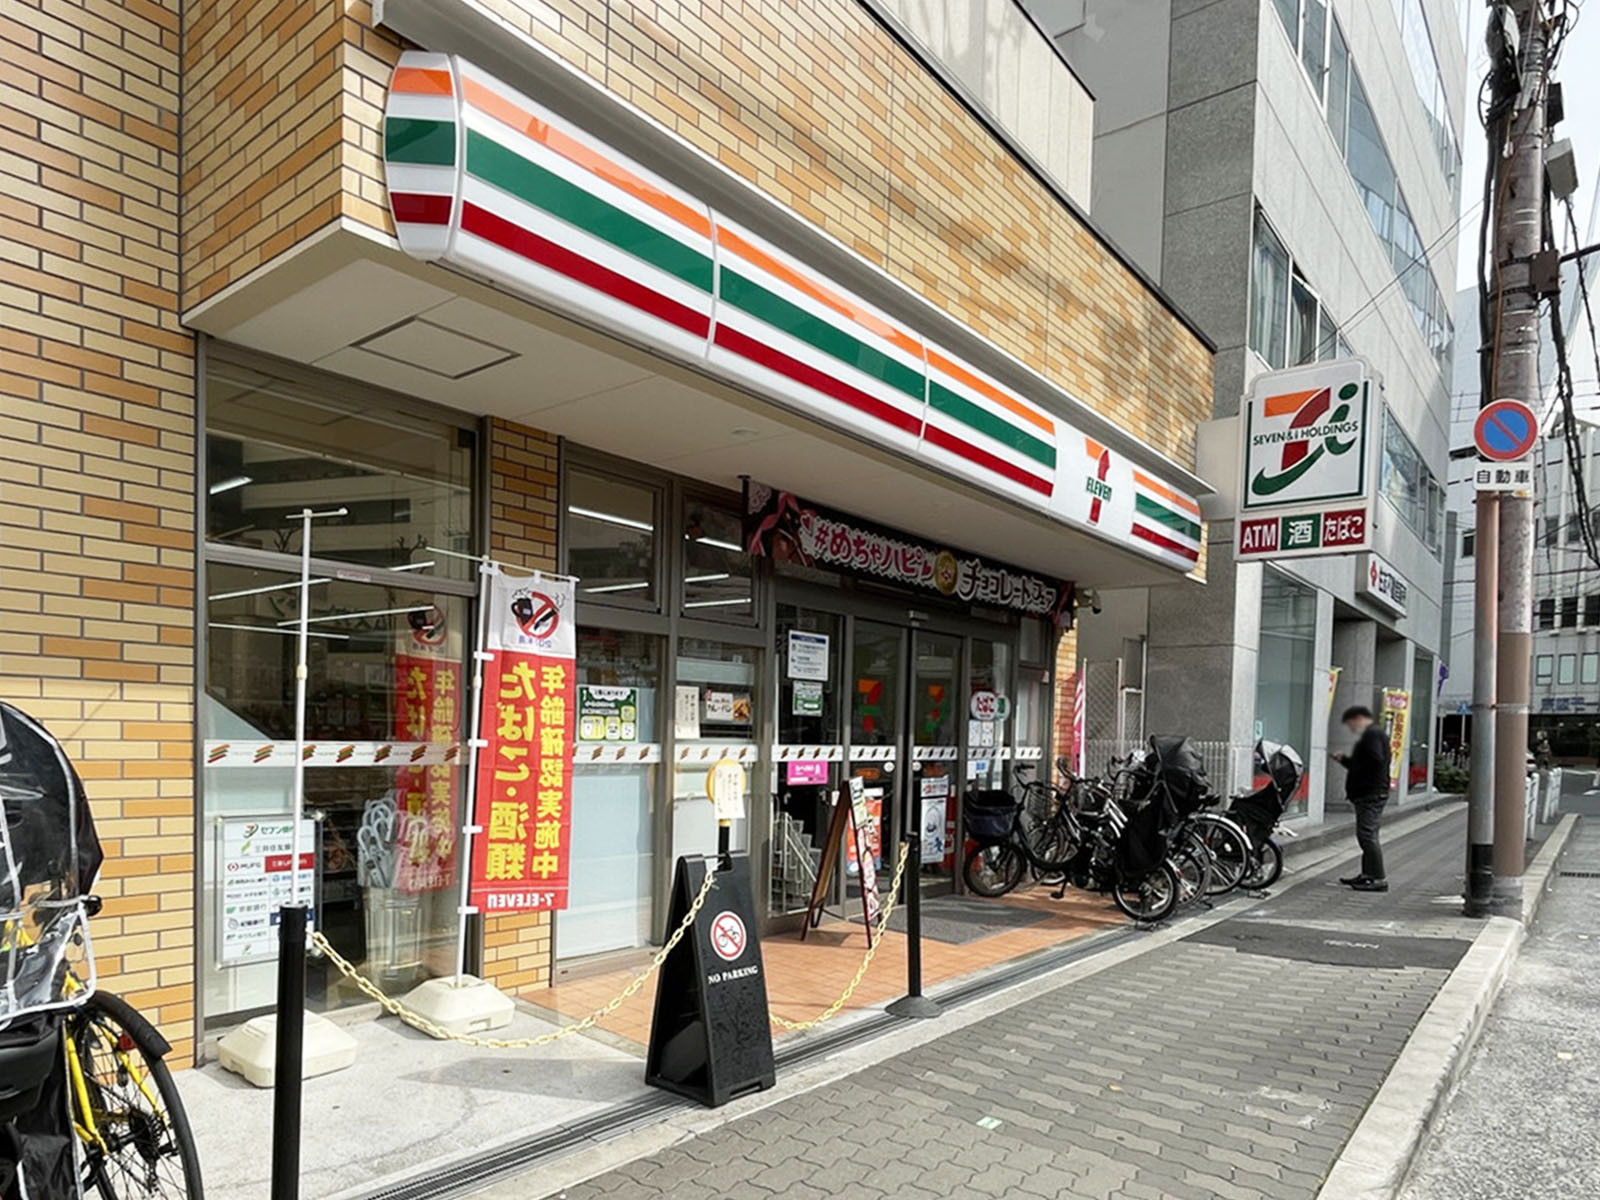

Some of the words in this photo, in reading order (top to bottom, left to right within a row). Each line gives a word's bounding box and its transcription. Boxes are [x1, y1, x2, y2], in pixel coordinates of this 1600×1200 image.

[1301, 420, 1359, 437] HOLDINGS
[1476, 468, 1530, 485] 自動車
[1242, 524, 1277, 549] ATM
[1287, 519, 1314, 546] 酒
[1324, 514, 1364, 541] たばこ
[707, 972, 721, 985] NO
[722, 965, 759, 982] PARKING
